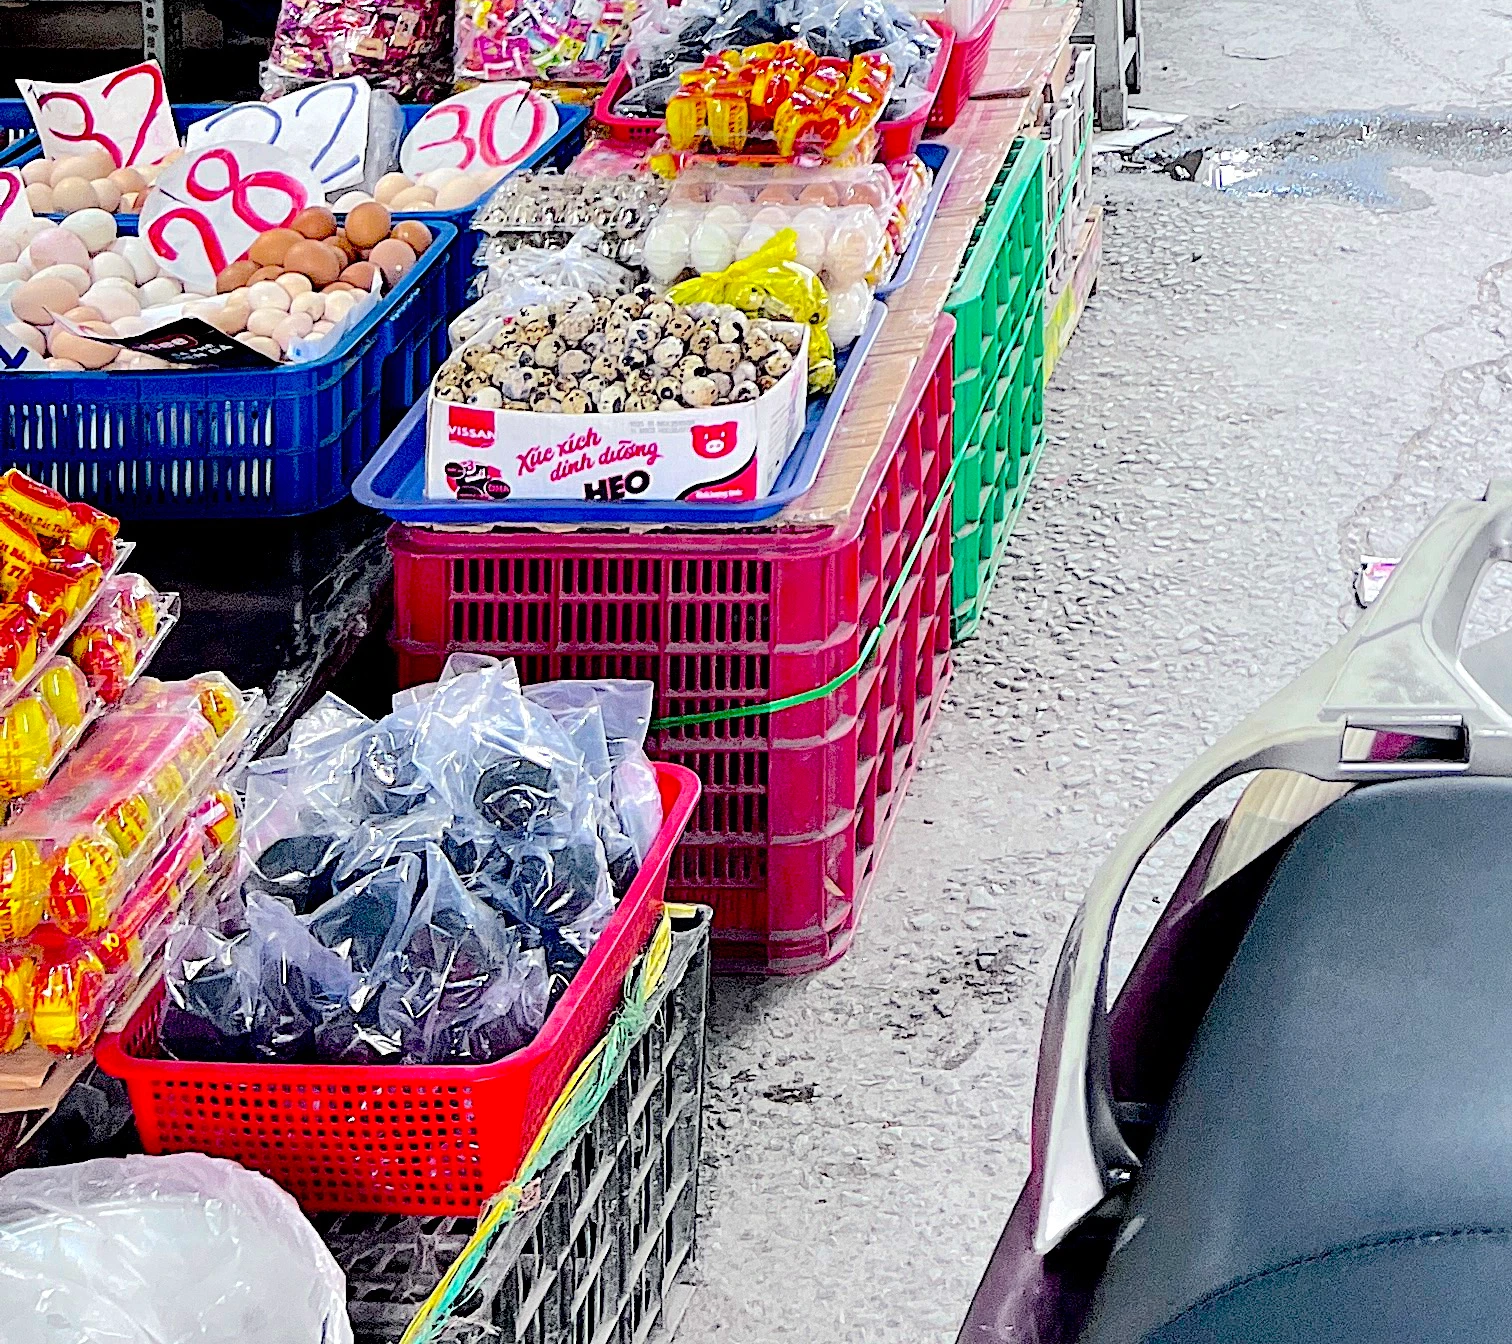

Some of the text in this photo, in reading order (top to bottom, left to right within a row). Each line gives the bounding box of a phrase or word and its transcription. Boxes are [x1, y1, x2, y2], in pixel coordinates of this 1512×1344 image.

[418, 87, 548, 171] 30
[448, 424, 495, 440] VISSAN
[516, 427, 602, 477] Xúc xích
[598, 440, 664, 466] dưỡng
[583, 469, 650, 501] HEO
